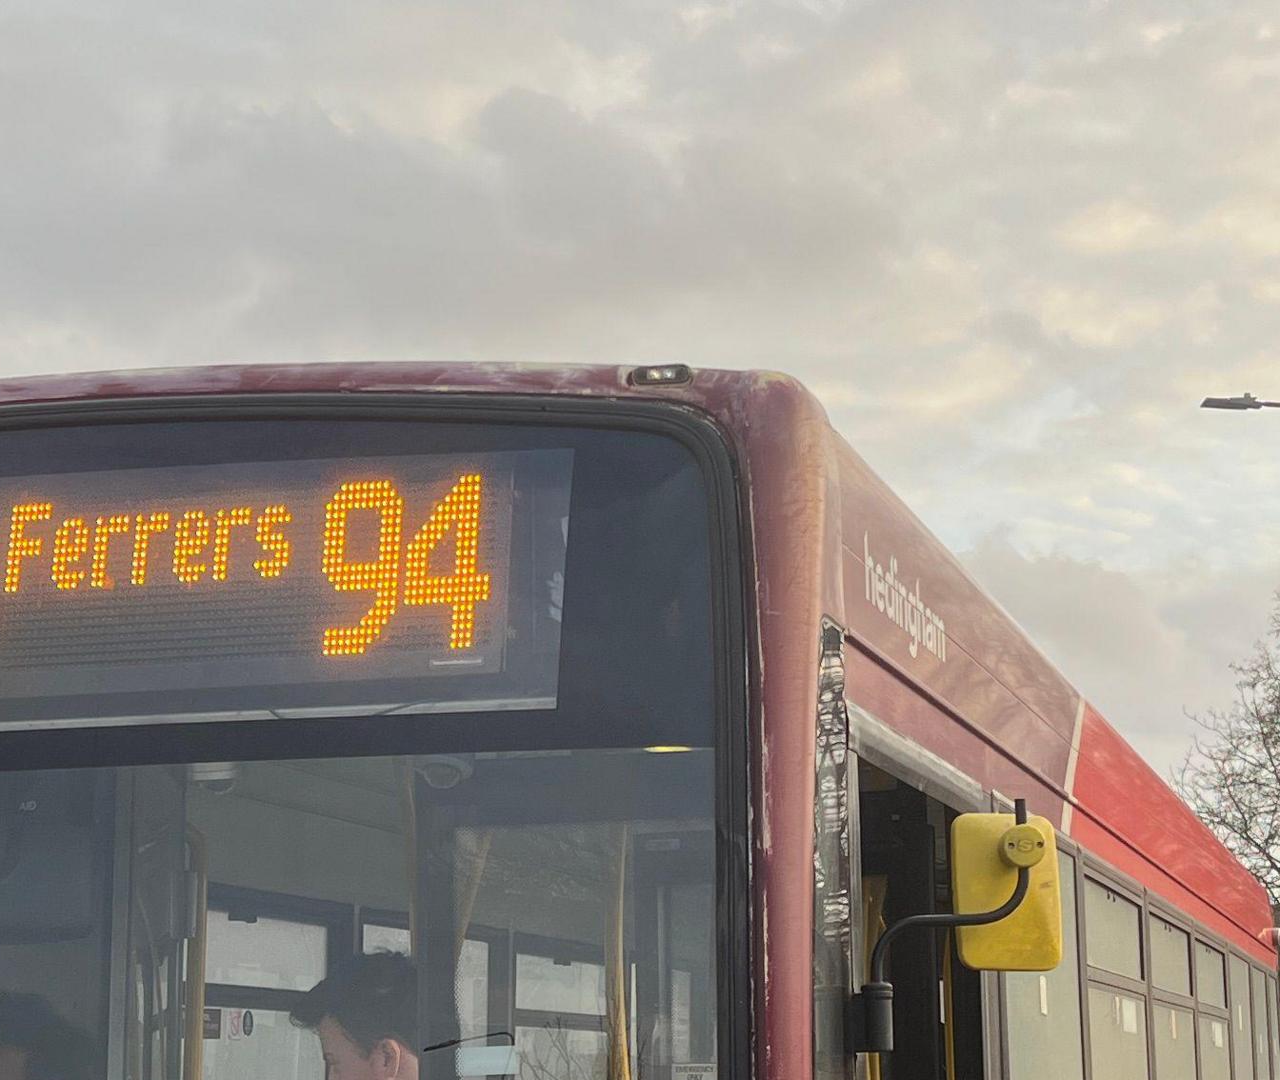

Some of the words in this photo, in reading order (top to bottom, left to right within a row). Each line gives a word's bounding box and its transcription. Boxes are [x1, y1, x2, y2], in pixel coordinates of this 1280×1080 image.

[4, 501, 292, 592] Ferrers
[321, 473, 490, 657] 94
[863, 531, 947, 662] hedingham
